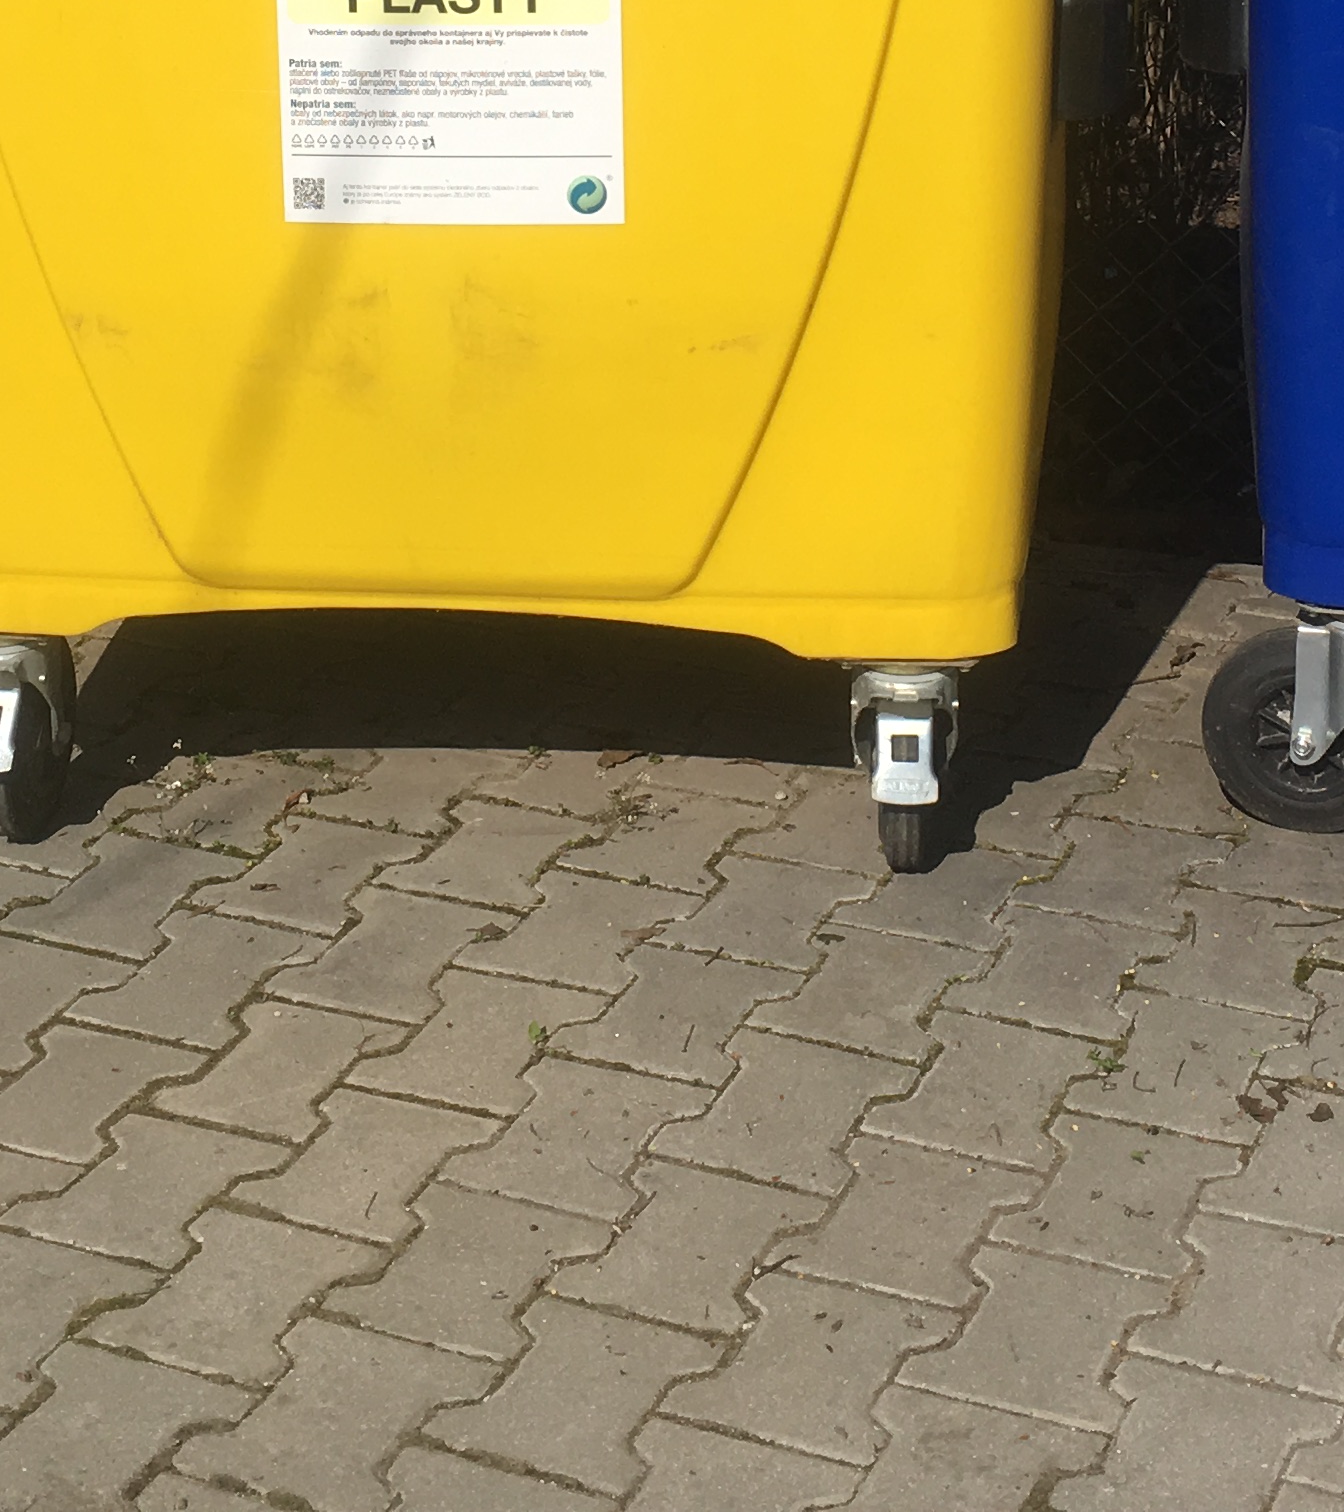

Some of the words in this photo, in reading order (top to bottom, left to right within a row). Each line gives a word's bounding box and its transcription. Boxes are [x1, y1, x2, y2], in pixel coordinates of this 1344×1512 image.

[350, 29, 381, 37] odpadu
[395, 29, 438, 37] správneho
[440, 29, 483, 38] kontajnera
[485, 30, 492, 38] aj
[494, 30, 504, 38] Vy
[506, 30, 551, 38] prispievate
[289, 58, 317, 68] Patria
[319, 60, 342, 68] sem:
[290, 99, 330, 110] Nepatria
[333, 101, 356, 109] sem:
